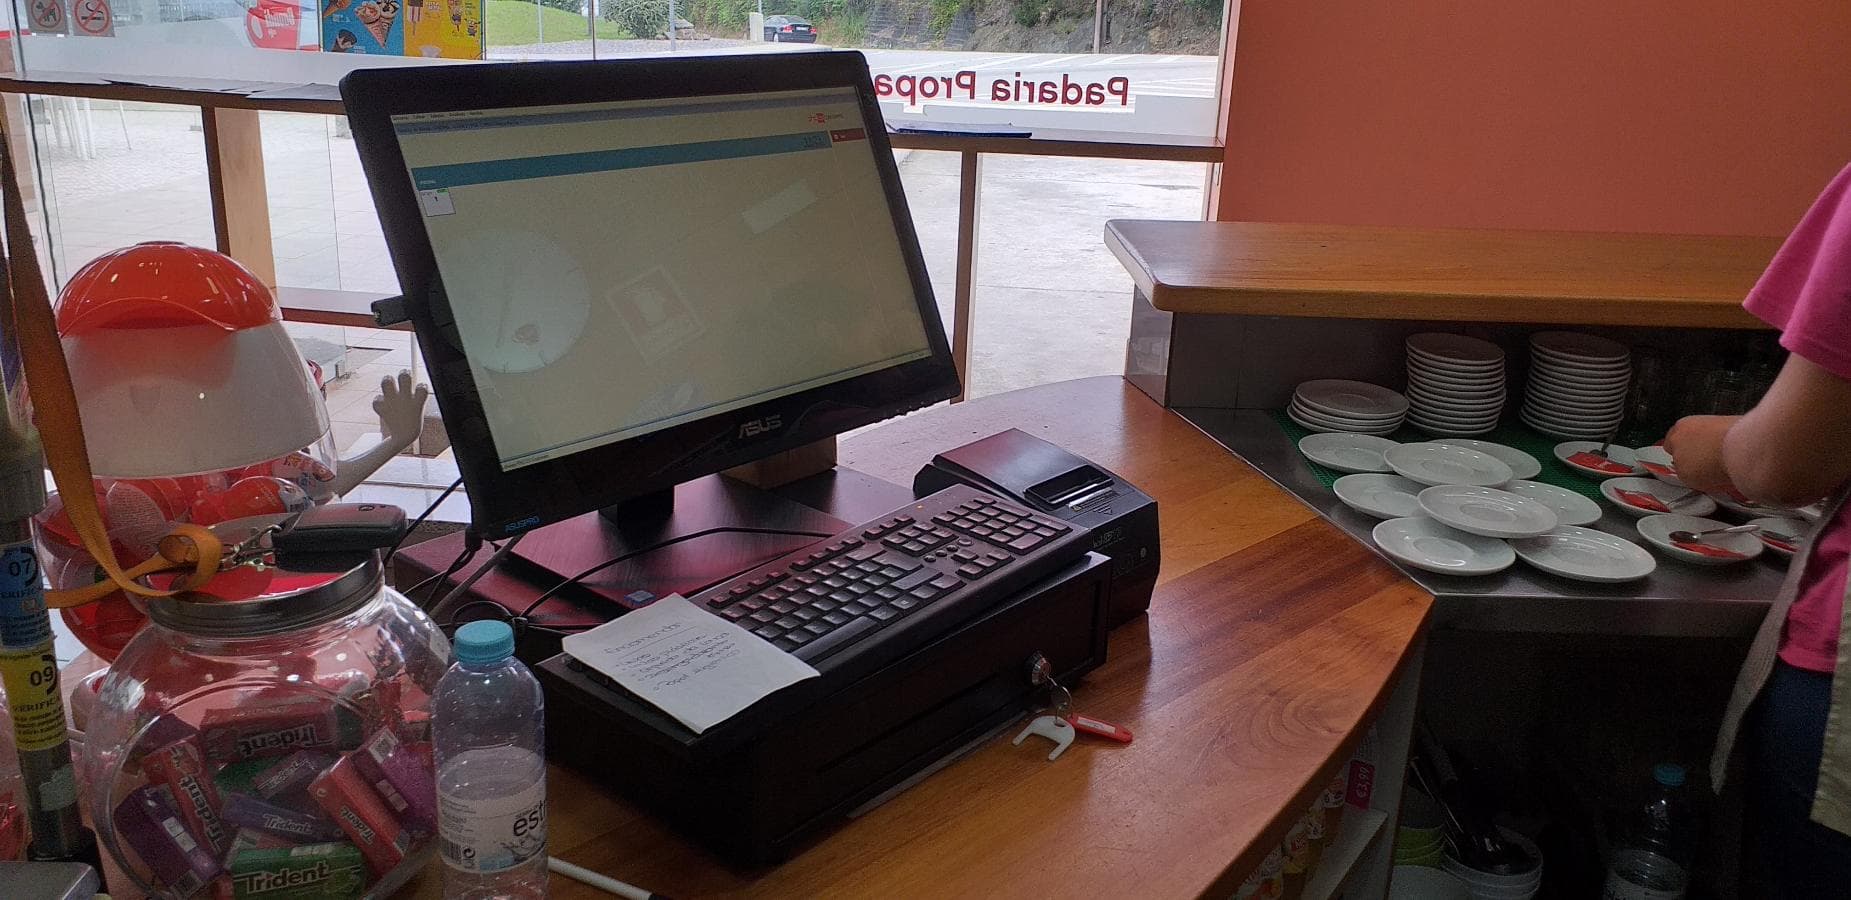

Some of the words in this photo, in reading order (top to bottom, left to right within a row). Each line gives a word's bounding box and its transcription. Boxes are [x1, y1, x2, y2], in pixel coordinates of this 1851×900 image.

[739, 414, 782, 438] ASUS
[9, 558, 32, 577] 07
[30, 666, 54, 687] 09
[239, 723, 318, 757] Trident
[262, 813, 313, 835] Trident
[233, 861, 330, 893] Trident
